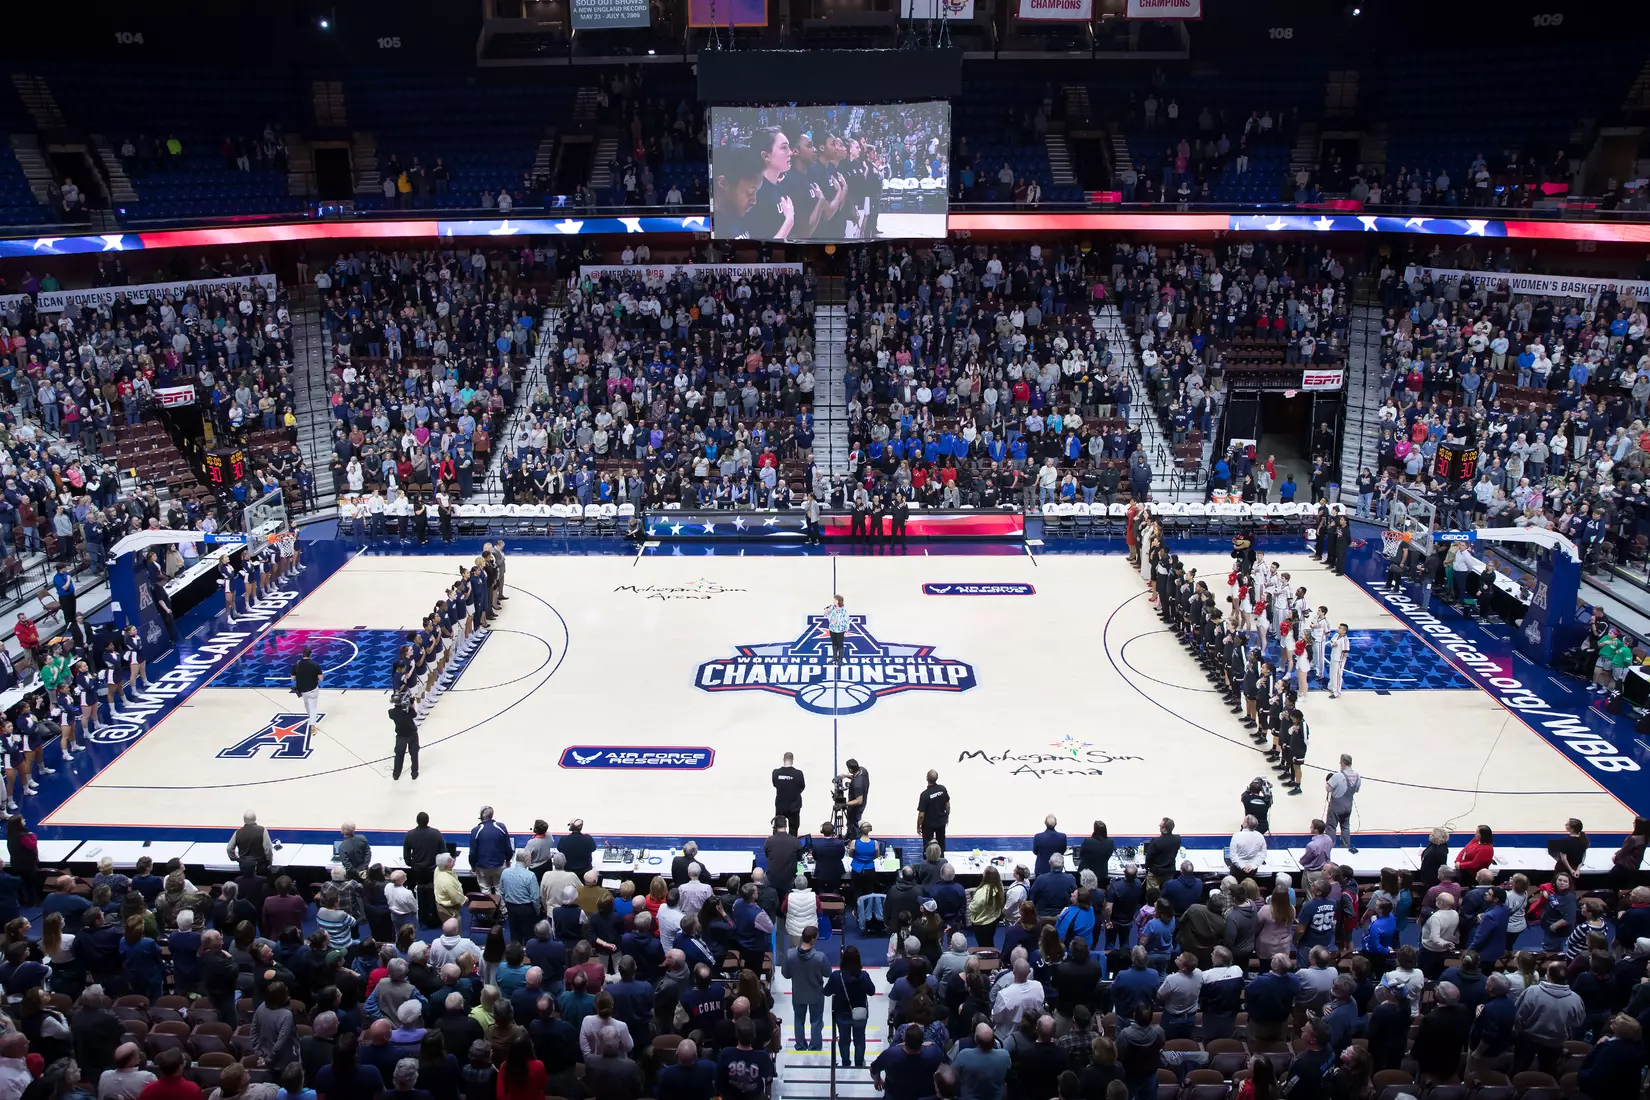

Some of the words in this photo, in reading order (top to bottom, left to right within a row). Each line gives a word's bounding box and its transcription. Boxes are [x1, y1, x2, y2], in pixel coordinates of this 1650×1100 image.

[1031, 0, 1081, 9] CHAMPIONS
[1532, 13, 1563, 27] 109
[115, 32, 144, 44] 104
[1268, 28, 1293, 39] 108
[377, 37, 401, 49] 105
[1512, 278, 1558, 291] WOMEN'S
[1560, 281, 1625, 296] BASKETBLL
[1304, 374, 1341, 385] ESPN
[155, 390, 194, 405] ESPN
[208, 465, 223, 483] 30
[231, 461, 244, 481] 30
[1437, 457, 1449, 477] 30
[1460, 461, 1474, 479] 30
[700, 663, 969, 686] CHAMPIONSHIP
[642, 752, 706, 760] FORCE
[958, 750, 1081, 765] Mohegan
[1086, 750, 1145, 764] Sun
[1009, 764, 1103, 779] Arena
[1317, 904, 1335, 913] JUDGE
[1312, 911, 1337, 931] 99
